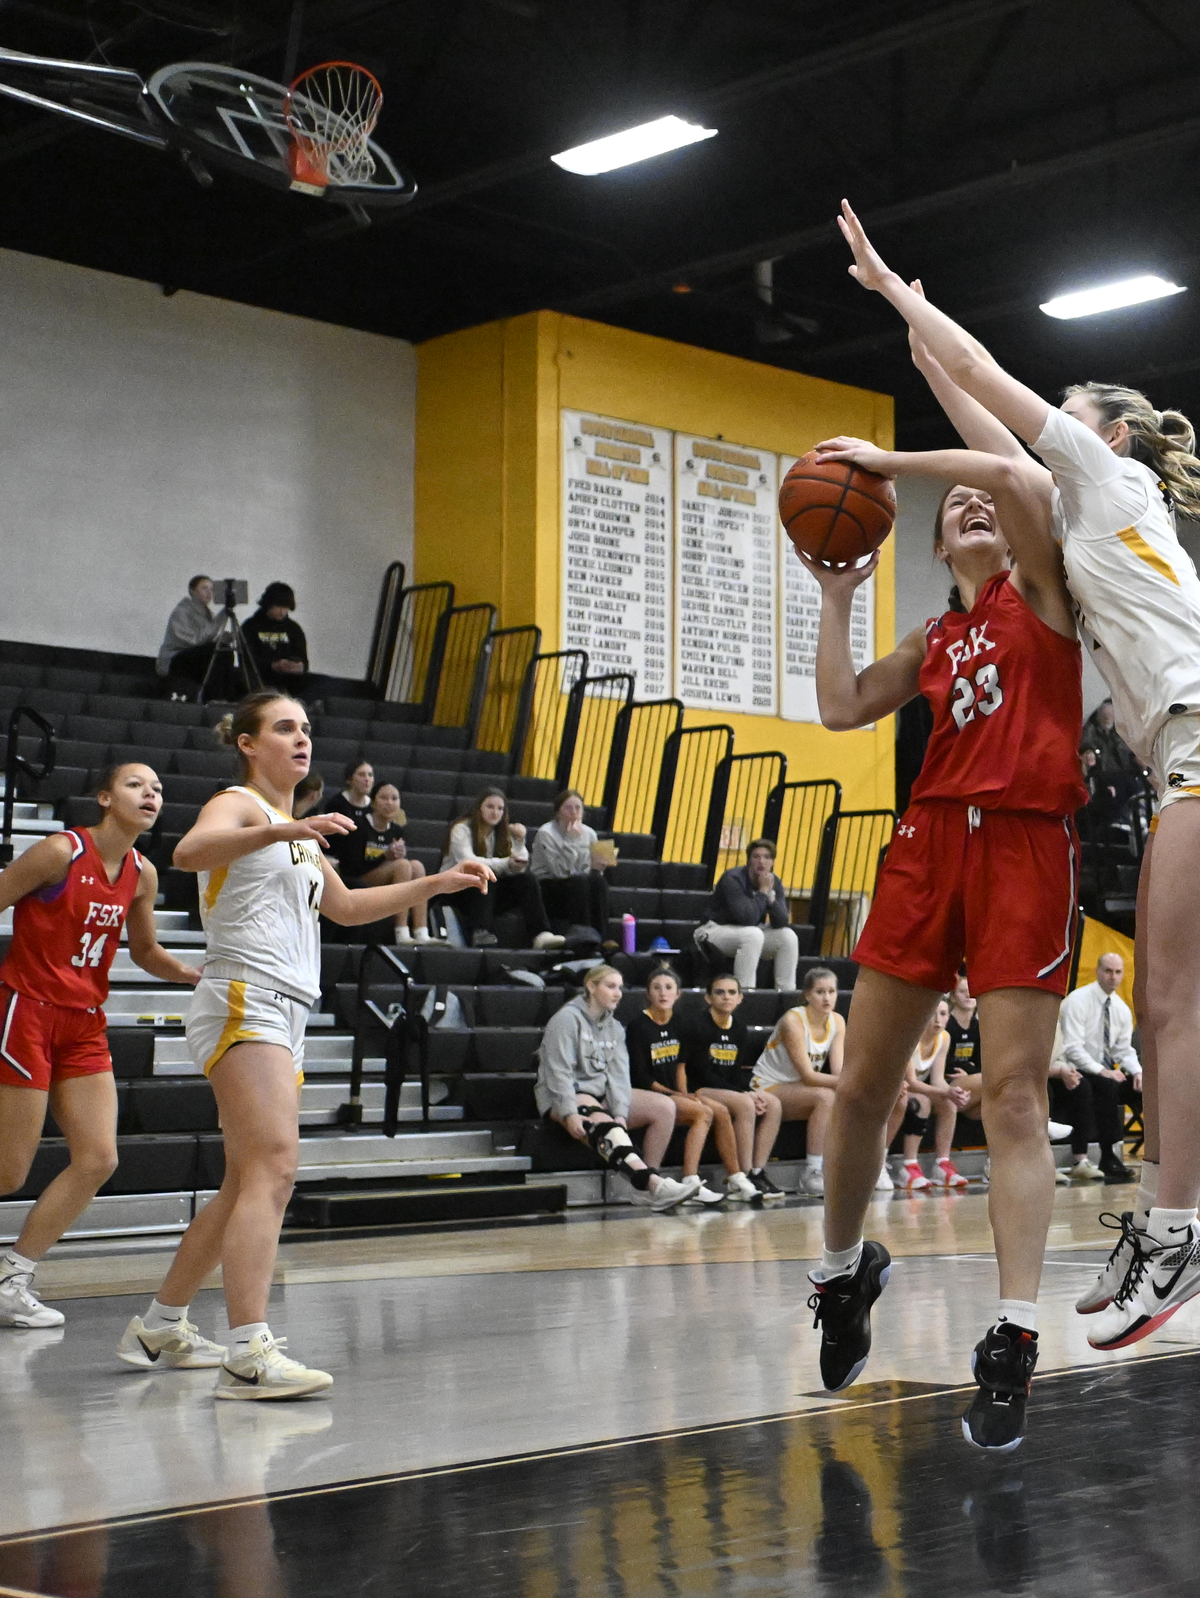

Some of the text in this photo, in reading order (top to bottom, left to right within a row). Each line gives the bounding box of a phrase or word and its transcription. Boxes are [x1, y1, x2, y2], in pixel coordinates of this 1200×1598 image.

[568, 478, 591, 491] FRED
[594, 483, 622, 497] BAKER
[568, 543, 589, 555] MIKE
[681, 562, 702, 574] MIKE
[594, 600, 626, 613] ASHLEY
[567, 608, 585, 619] KIM
[681, 612, 709, 625] JAMES
[567, 635, 590, 647] MIKE
[682, 650, 707, 662] EMILY
[681, 675, 700, 687] JILL
[681, 687, 713, 700] JOSHUA
[716, 692, 741, 704] LEWIS
[951, 662, 1004, 734] 23
[84, 901, 124, 927] FSK
[70, 932, 109, 968] 34
